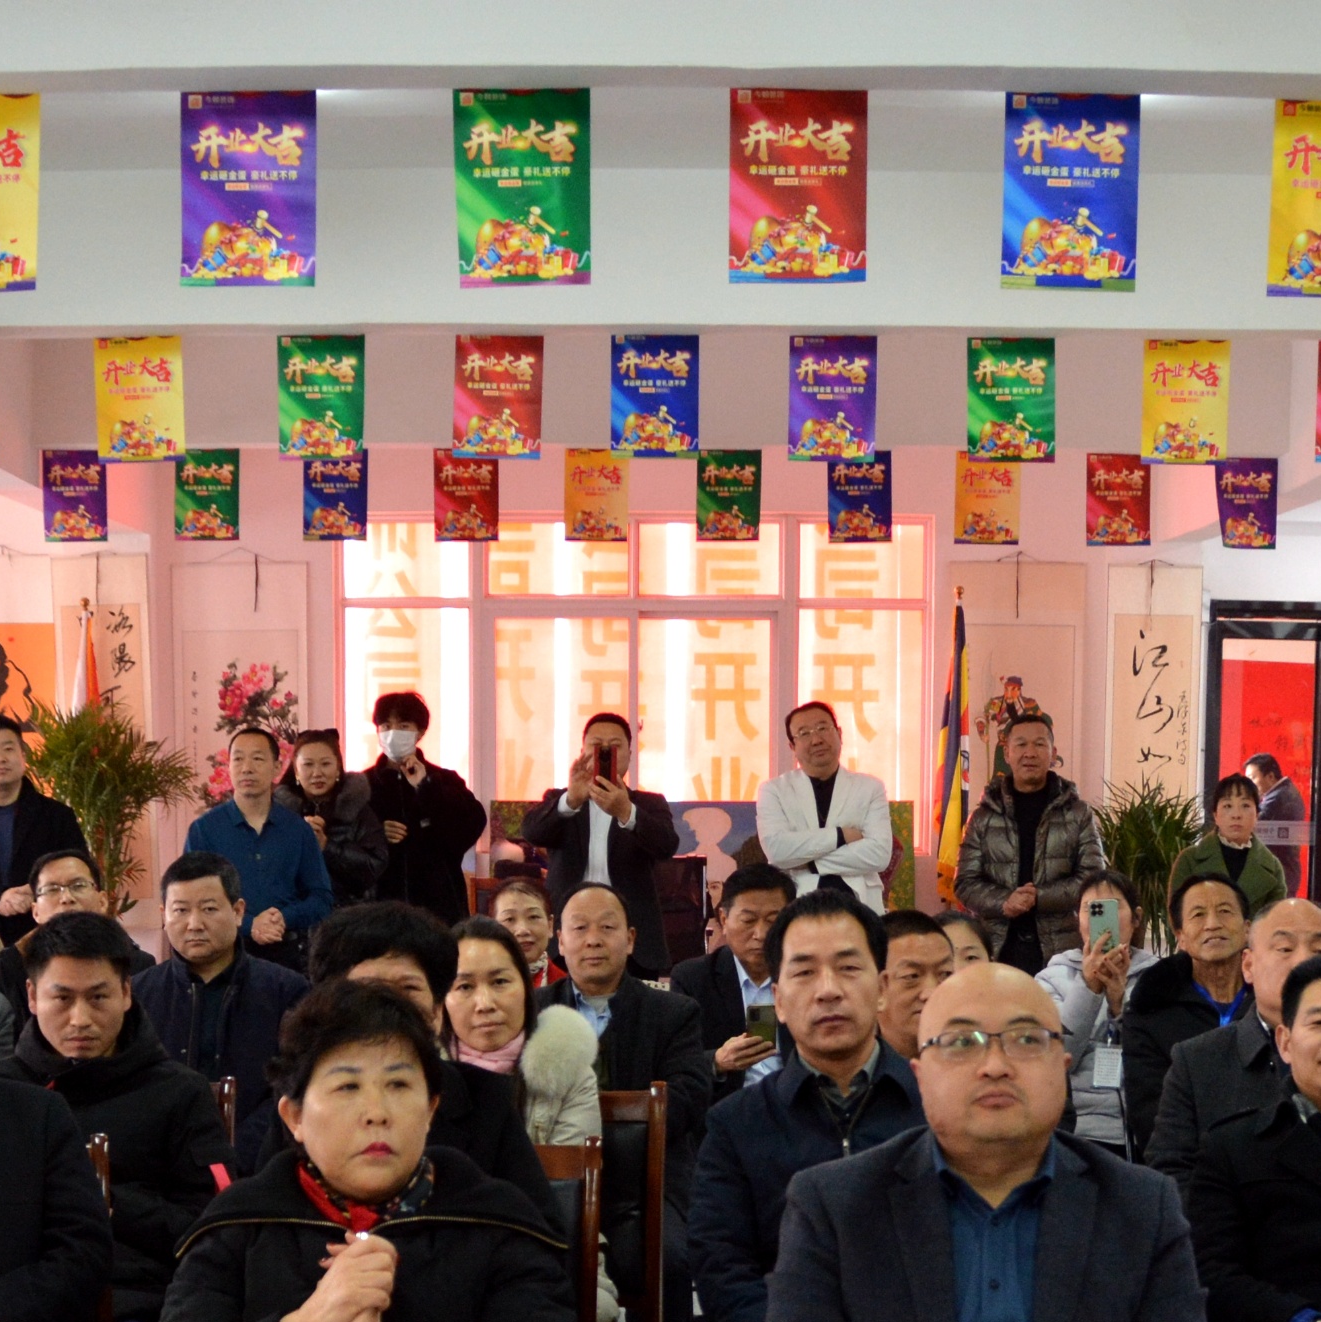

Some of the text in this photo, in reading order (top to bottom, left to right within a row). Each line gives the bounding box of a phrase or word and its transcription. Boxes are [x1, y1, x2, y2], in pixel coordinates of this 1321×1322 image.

[191, 121, 304, 168] 开业大吉
[465, 119, 578, 167] 开业大吉
[740, 118, 856, 164] 开业大吉
[1015, 120, 1128, 166] 开业大吉
[101, 356, 174, 385] 开业大吉
[284, 355, 356, 385] 开业大吉
[462, 352, 535, 381] 开业大吉
[617, 349, 691, 379] 开业大吉
[796, 355, 868, 385] 开业大吉
[974, 357, 1047, 387] 开业大吉
[1150, 359, 1222, 389] 开业大吉
